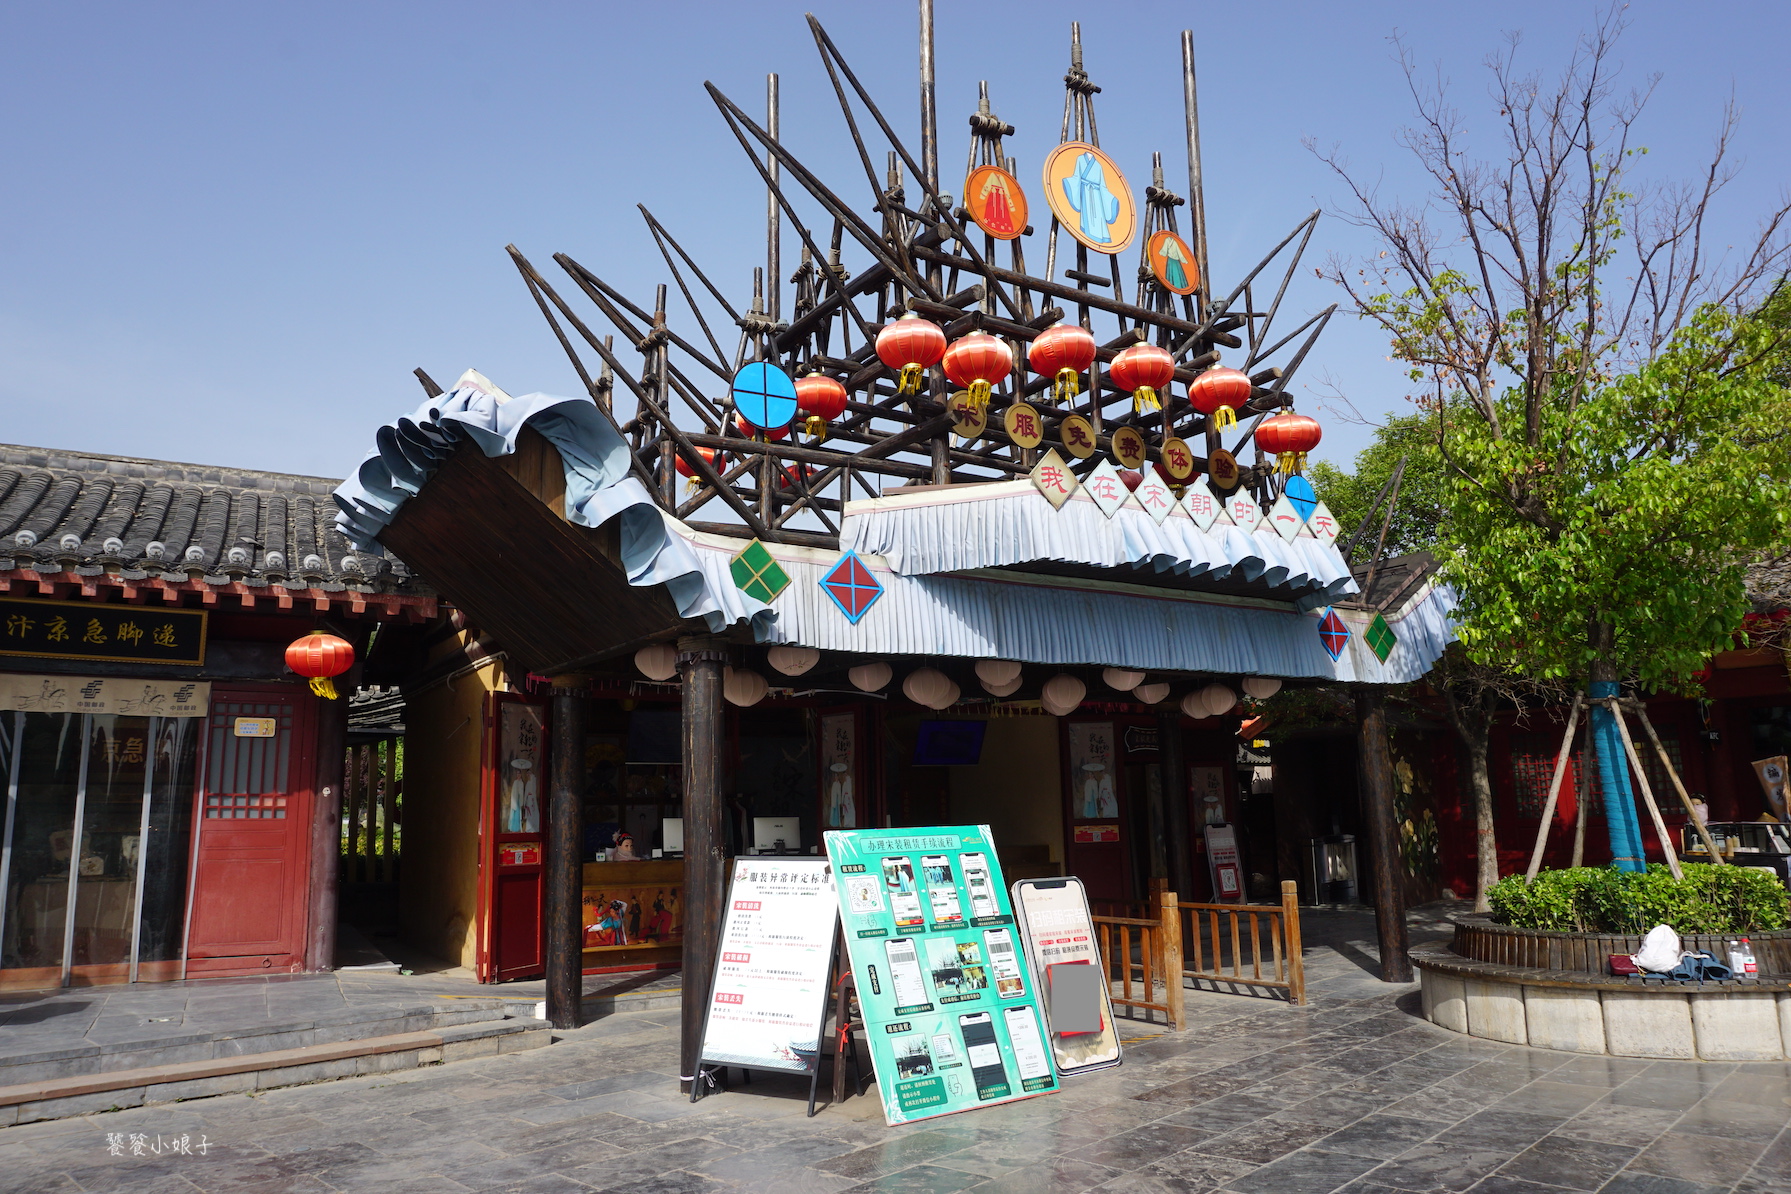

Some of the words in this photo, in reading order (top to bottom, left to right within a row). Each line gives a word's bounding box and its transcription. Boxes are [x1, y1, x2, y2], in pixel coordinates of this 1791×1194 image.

[957, 402, 1233, 479] 宋服免费体验
[1041, 465, 1335, 537] 我在宋朝的一天
[6, 614, 179, 648] 汴京急脚递
[77, 700, 105, 708] 中国邮政
[867, 837, 953, 851] 办理宋装租赁手续流程
[749, 872, 830, 884] 服装异常评定标准
